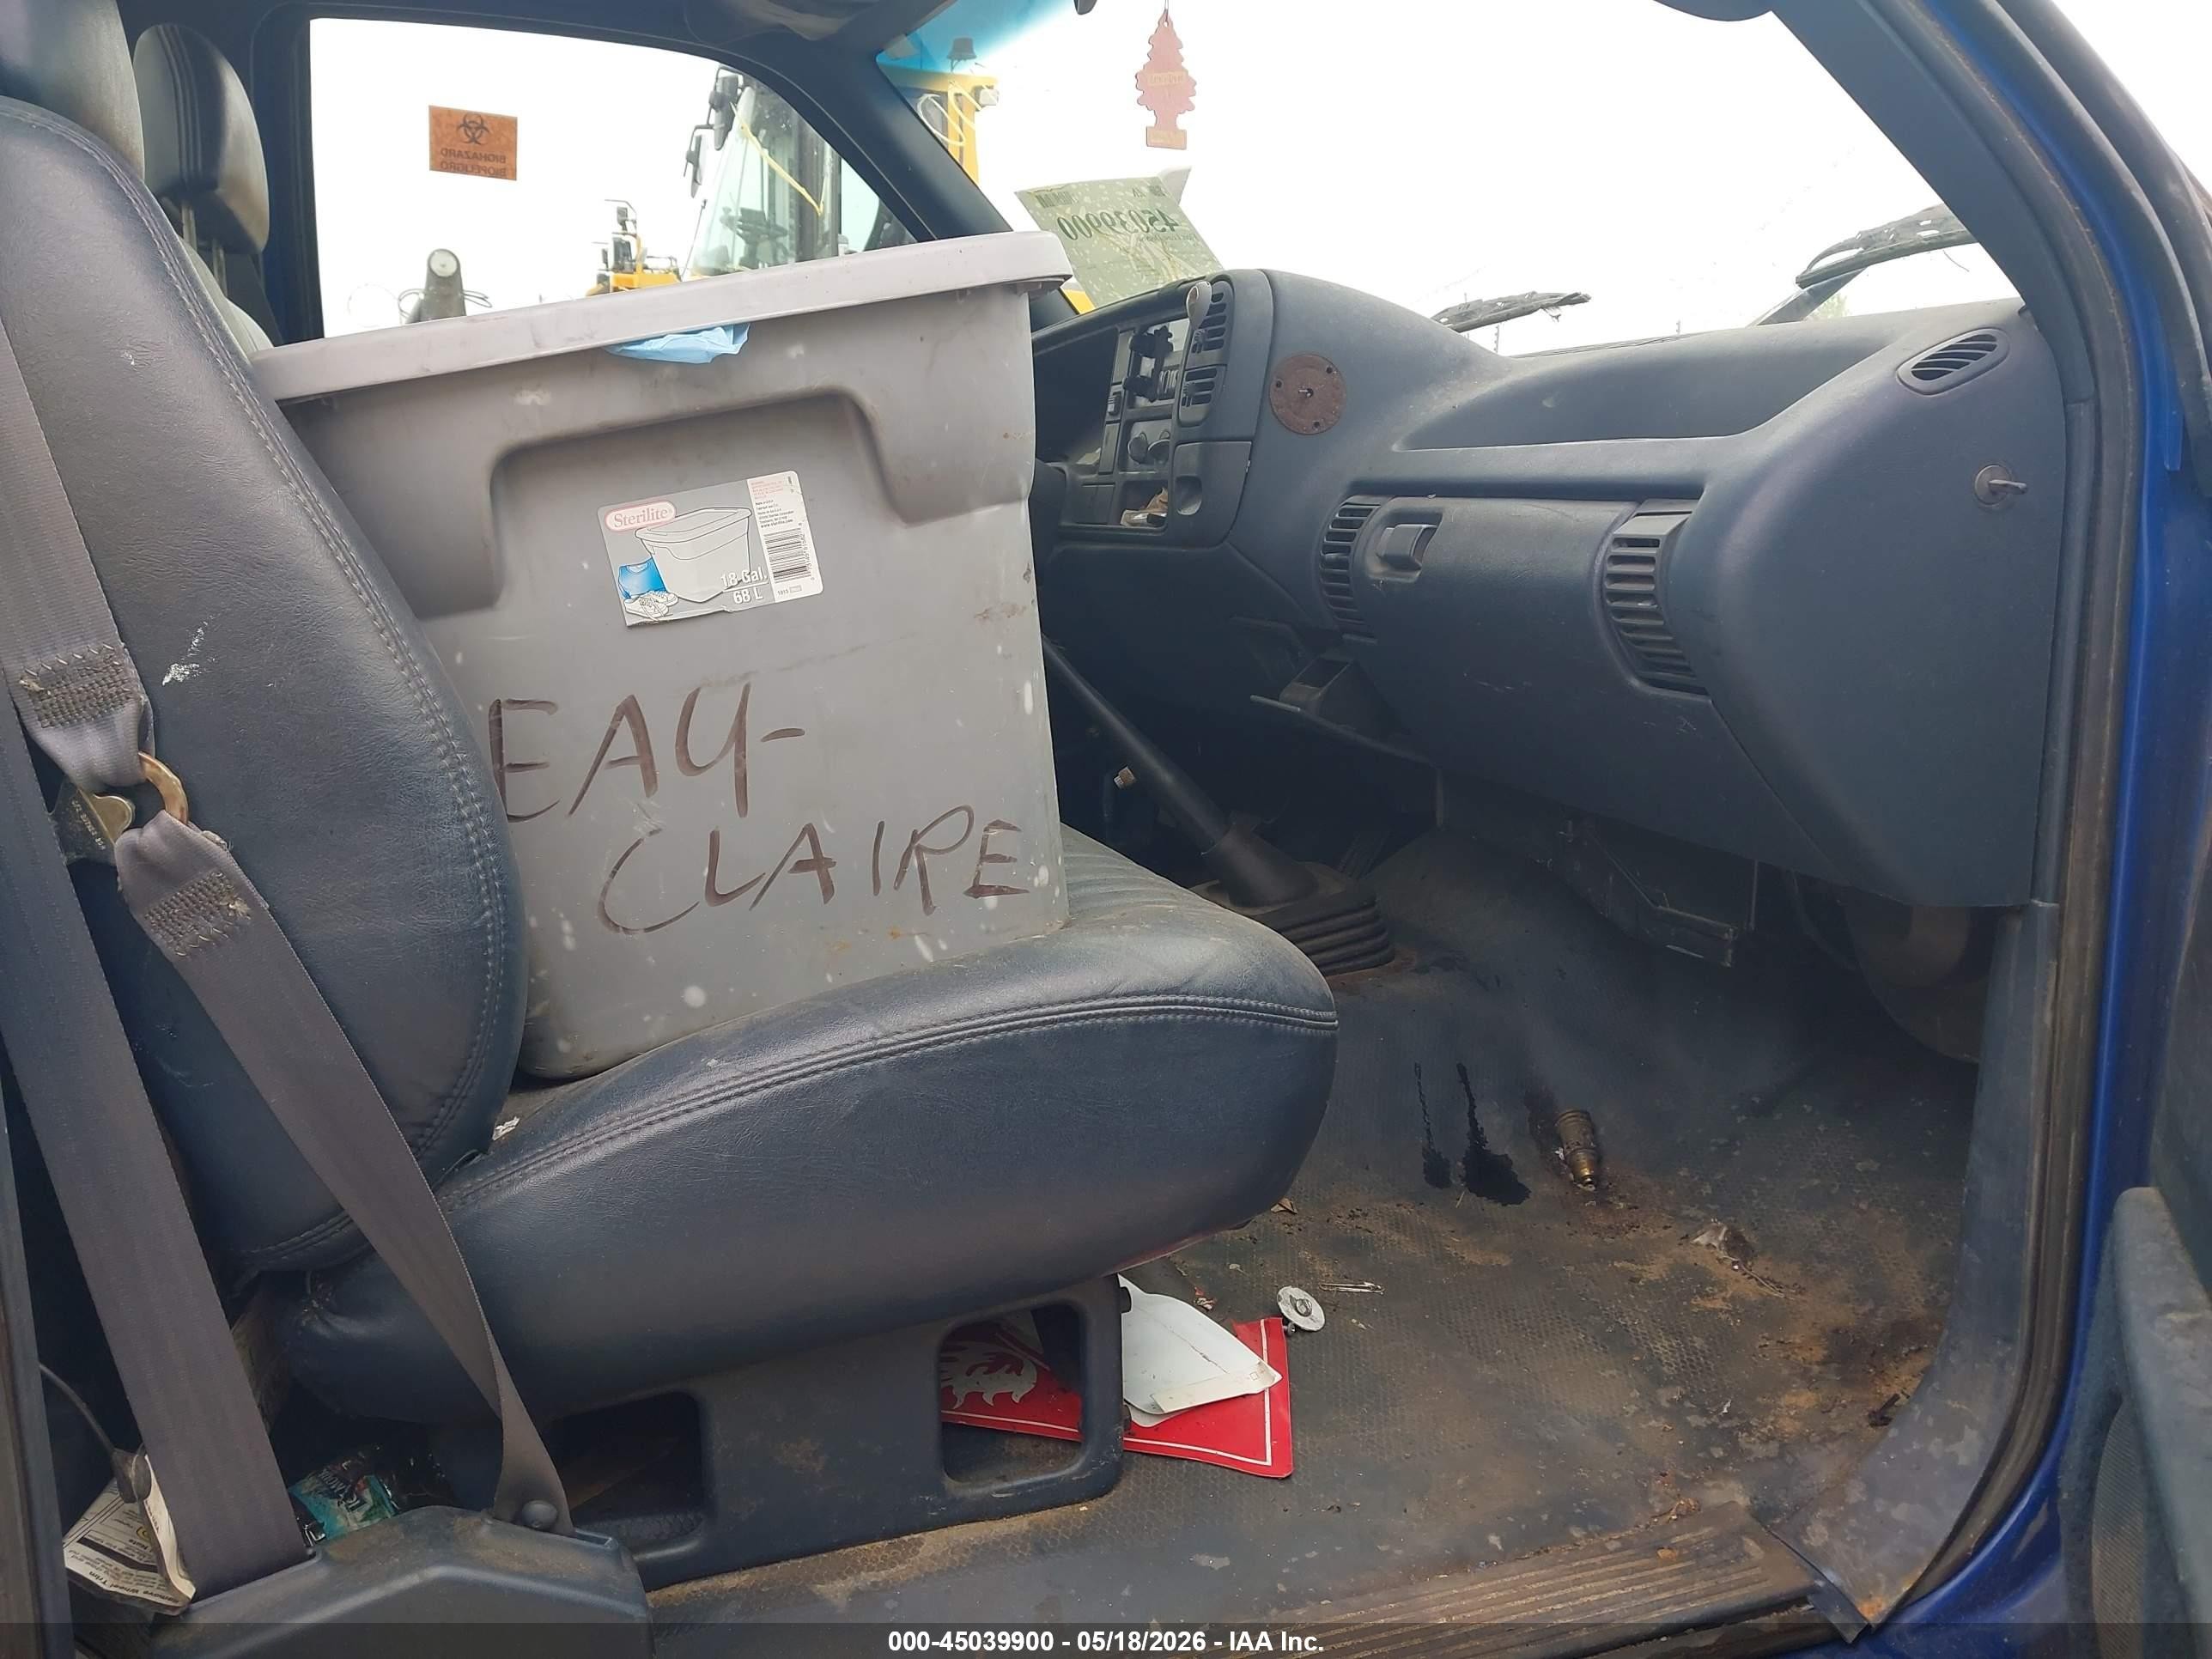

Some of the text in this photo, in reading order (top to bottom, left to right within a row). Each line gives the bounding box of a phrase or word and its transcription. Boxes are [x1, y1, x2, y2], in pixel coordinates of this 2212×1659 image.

[613, 507, 668, 528] Sterilite
[721, 566, 769, 587] 18 Gal.
[733, 586, 764, 604] 68 L
[600, 805, 1030, 933] CLAIRE
[88, 1571, 108, 1585] Trim
[109, 1583, 140, 1595] Wheel
